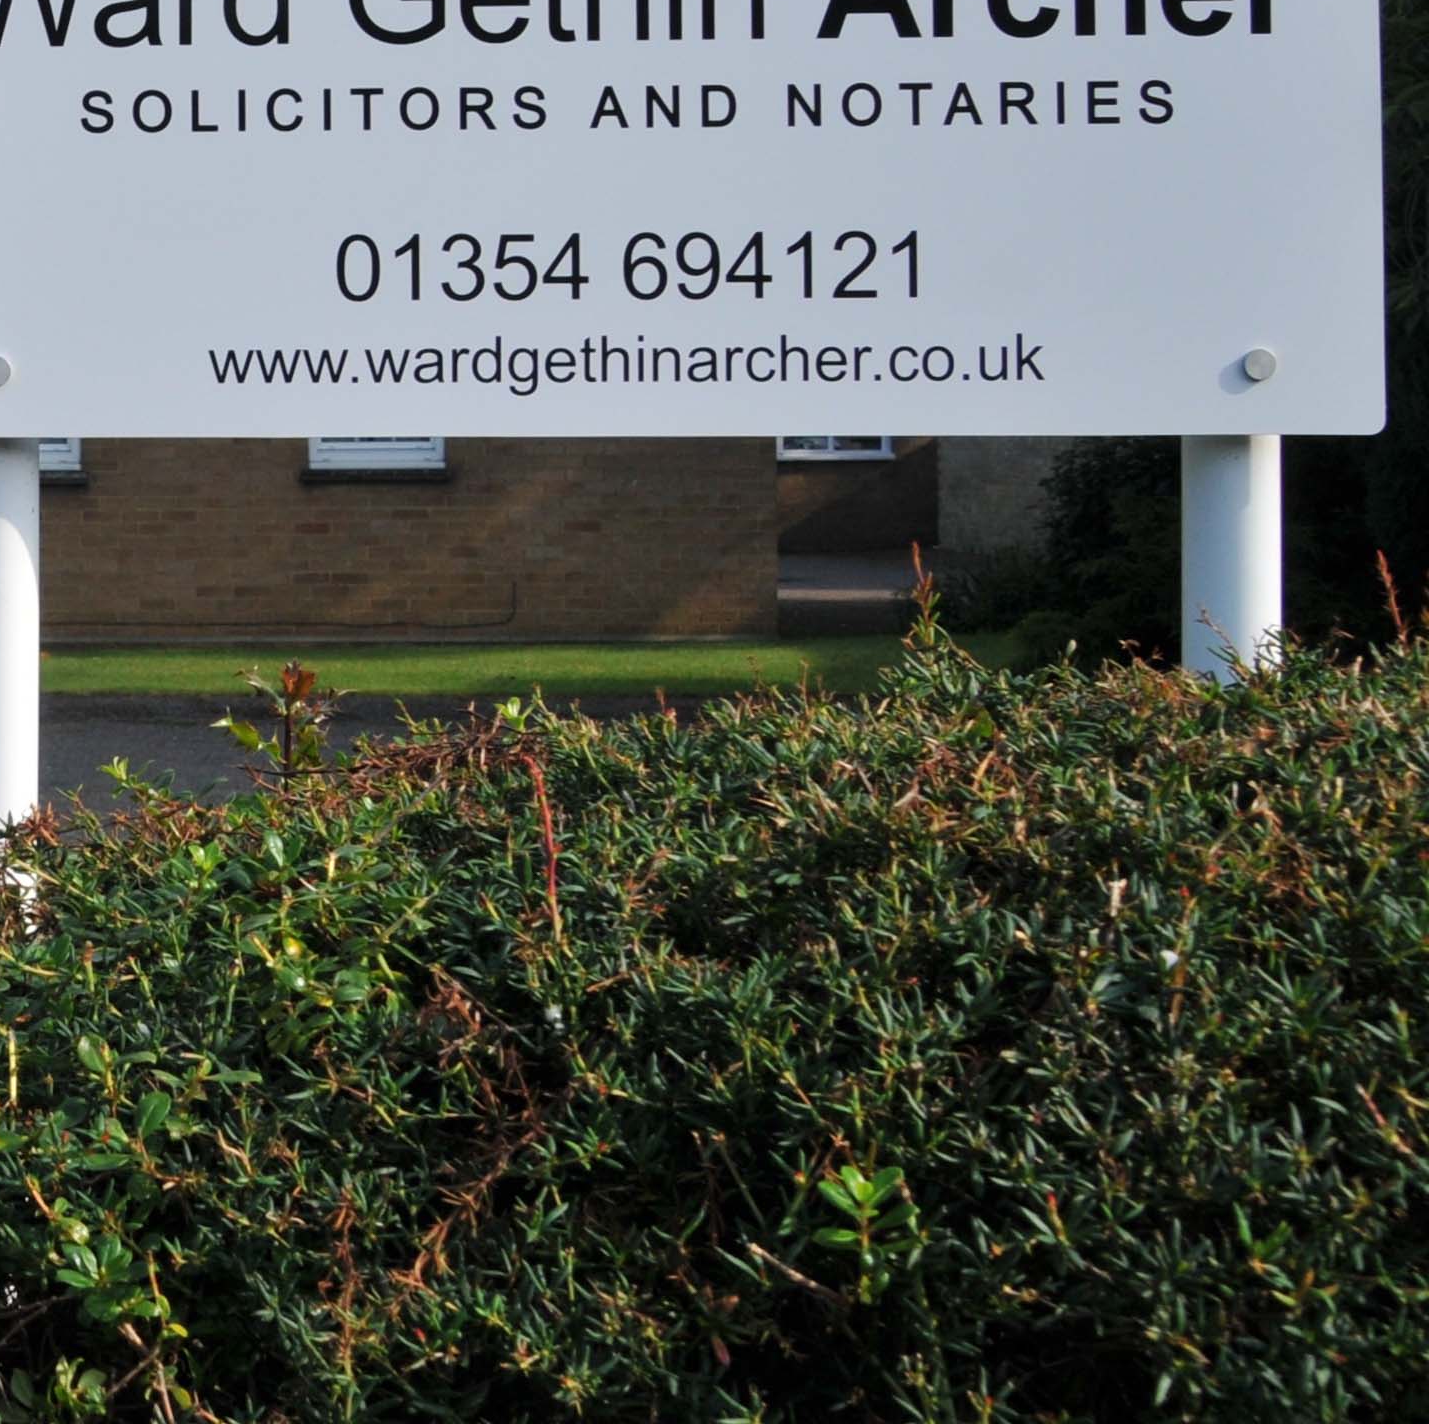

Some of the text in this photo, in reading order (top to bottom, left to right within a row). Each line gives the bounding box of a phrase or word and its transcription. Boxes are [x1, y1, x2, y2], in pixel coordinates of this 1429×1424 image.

[80, 79, 1175, 134] SOLICITORS AND NOTARIES
[336, 230, 918, 302] 01354 694121
[208, 333, 1045, 396] www.wardgethinarcher.co.uk
